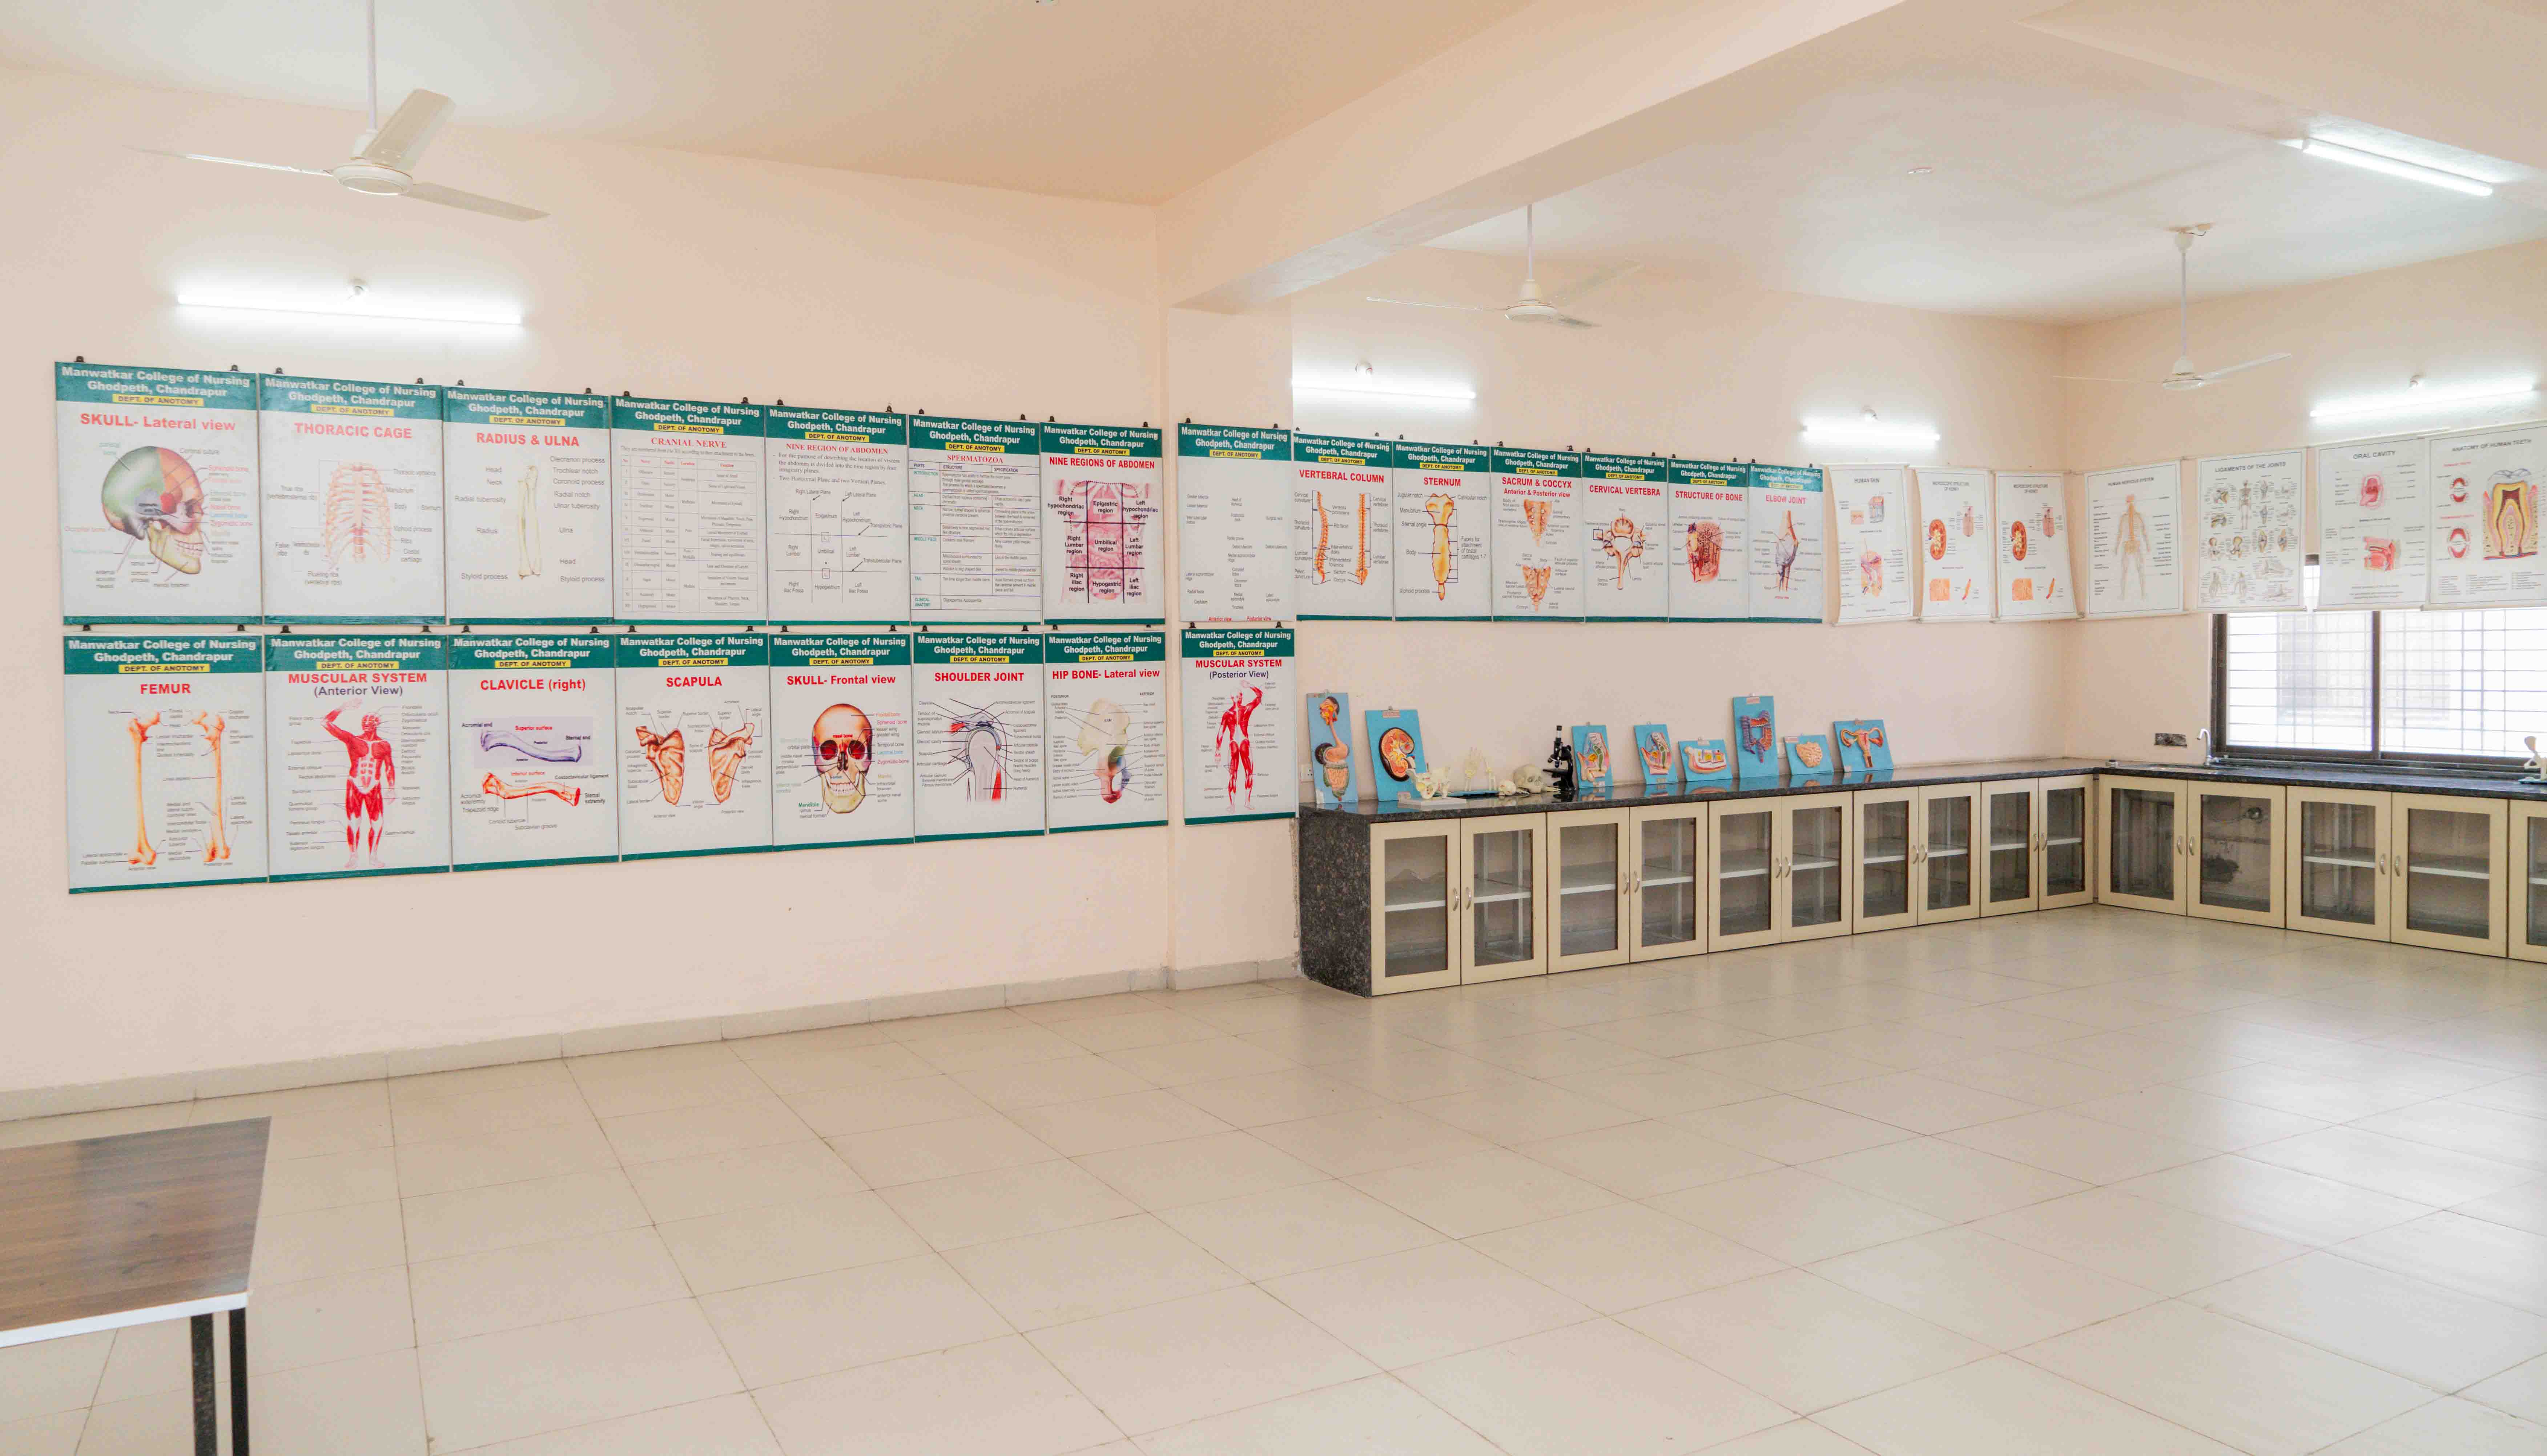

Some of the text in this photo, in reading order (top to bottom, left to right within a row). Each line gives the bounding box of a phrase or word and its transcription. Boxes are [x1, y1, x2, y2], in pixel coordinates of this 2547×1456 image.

[61, 367, 250, 388] Manwatkar College of Nursing
[88, 381, 227, 397] Ghodpeth, Chandrapur
[117, 396, 141, 404] DEPT.
[158, 398, 199, 406] ANOTOMY
[80, 412, 236, 431] SKULL- Lateral view
[294, 422, 413, 439] THORACIC CAGE
[476, 432, 579, 446] RADIUS & ULNA
[651, 437, 727, 448] CRANIAL NERVE
[1431, 446, 1454, 455] College
[1464, 448, 1487, 457] Nursing
[947, 455, 1003, 464] SPERMATOZOA
[1049, 456, 1155, 469] NINE REGIONS OF ABDOMEN
[1408, 453, 1475, 464] Ghodpeth, Chandrapur
[1299, 469, 1384, 483] VERTEBRAL COLUMN
[1424, 477, 1461, 487] STERNUM
[1502, 477, 1533, 486] SACRUM
[1542, 479, 1572, 489] COCCYX
[1589, 485, 1661, 496] CERVICAL VERTEBRA
[1675, 491, 1713, 500] STRUCTURE
[1725, 493, 1743, 501] BONE
[1766, 495, 1786, 503] ELBOW
[918, 636, 964, 644] Manwatkar
[966, 636, 997, 645] College
[1009, 637, 1040, 646] Nursing
[934, 646, 1025, 655] Ghodpeth, Chandrapur
[1195, 659, 1282, 668] MUSCULAR SYSTEM
[289, 672, 427, 684] MUSCULAR SYSTEM
[934, 672, 1024, 682] SHOULDER JOINT
[1053, 669, 1160, 679] HIP BONE- Lateral view
[1209, 670, 1269, 680] (Posterior View)
[480, 679, 586, 692] CLAVICLE (right)
[666, 676, 722, 687] SCAPULA
[787, 675, 896, 685] SKULL- Frontal view
[140, 683, 191, 694] FEMUR
[313, 685, 403, 698] (Anterior View)
